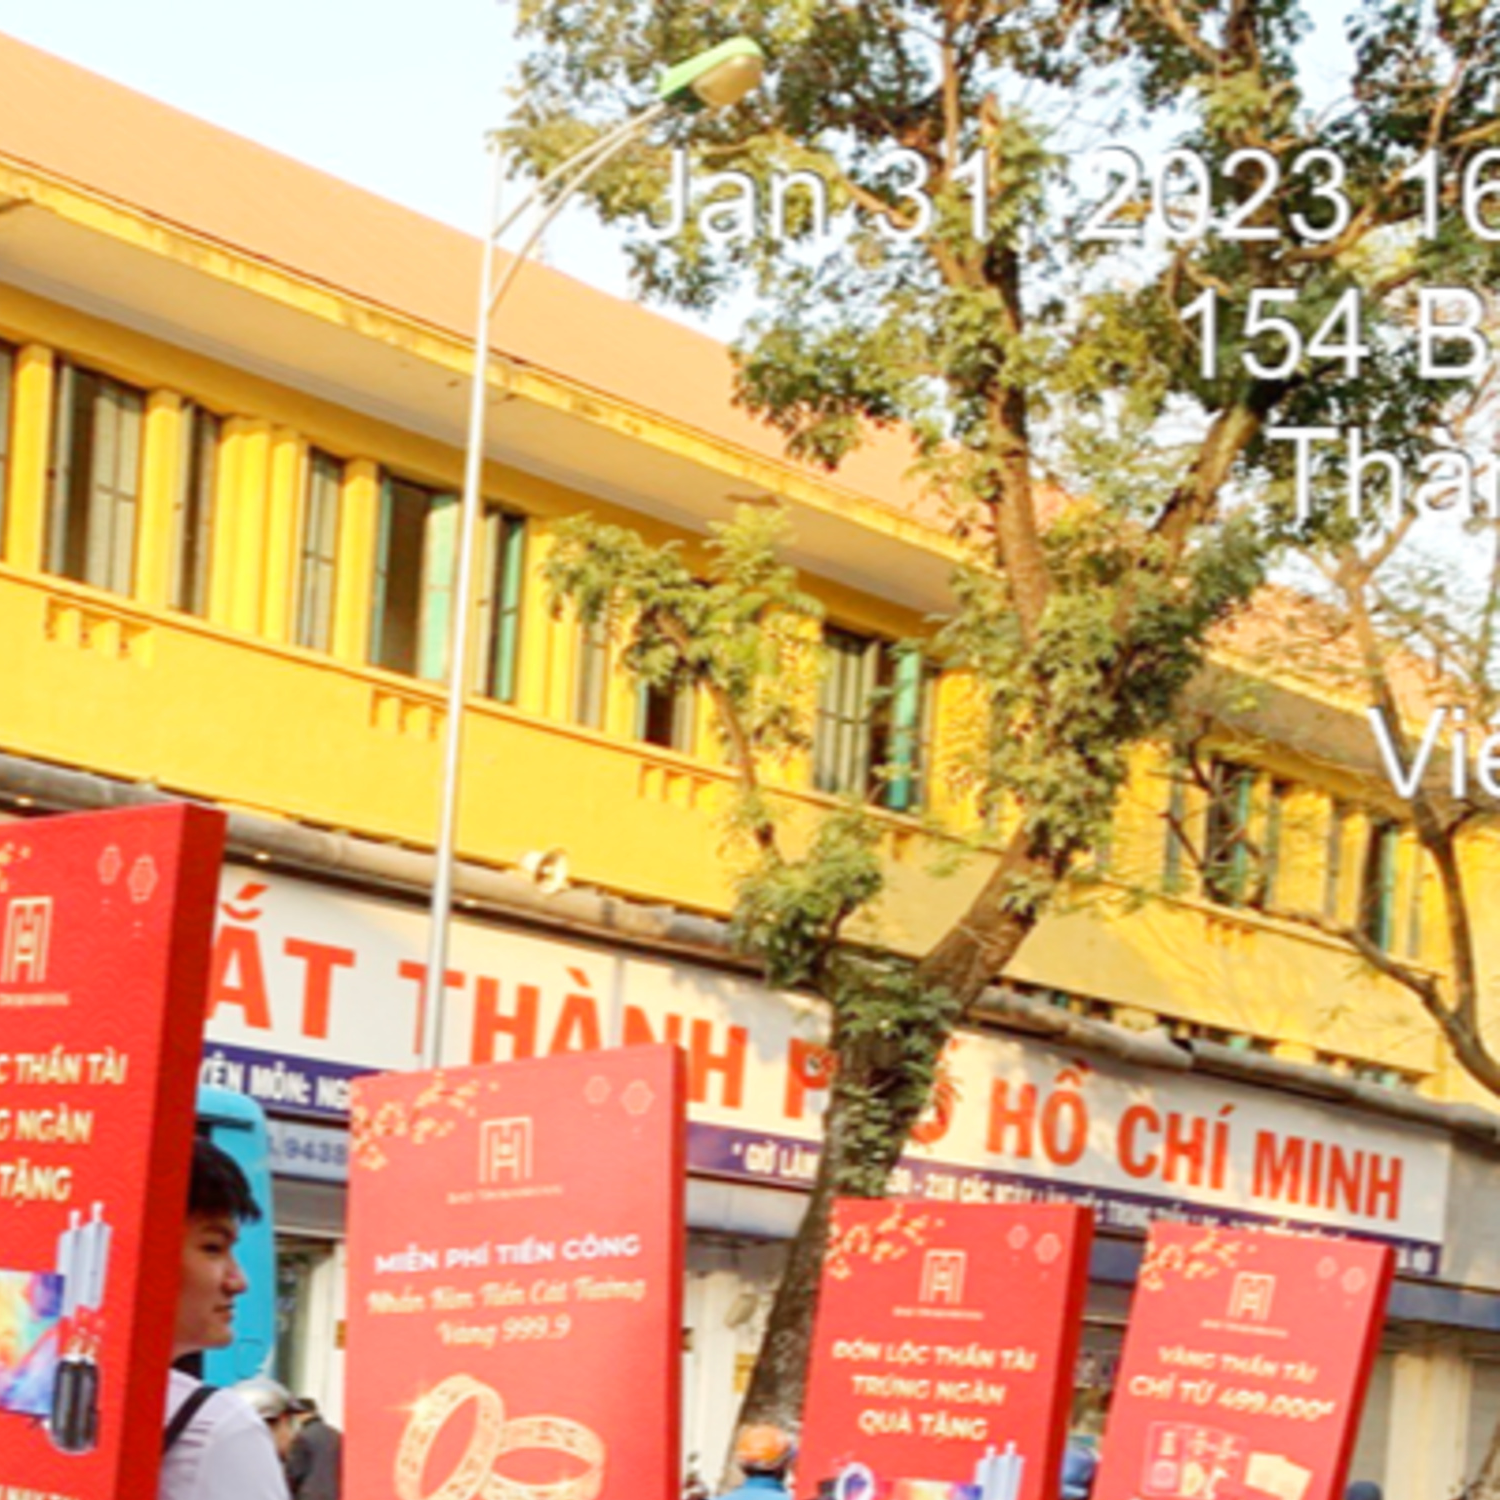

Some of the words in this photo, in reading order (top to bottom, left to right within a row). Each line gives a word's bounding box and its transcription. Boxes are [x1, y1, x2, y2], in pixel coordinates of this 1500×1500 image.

[87, 1045, 130, 1085] TÀI
[15, 1101, 95, 1144] NGÀN
[986, 1058, 1090, 1167] HỒ
[1117, 1104, 1235, 1191] CHÍ
[1252, 1130, 1404, 1221] MINH
[561, 1231, 641, 1261] CÔNG
